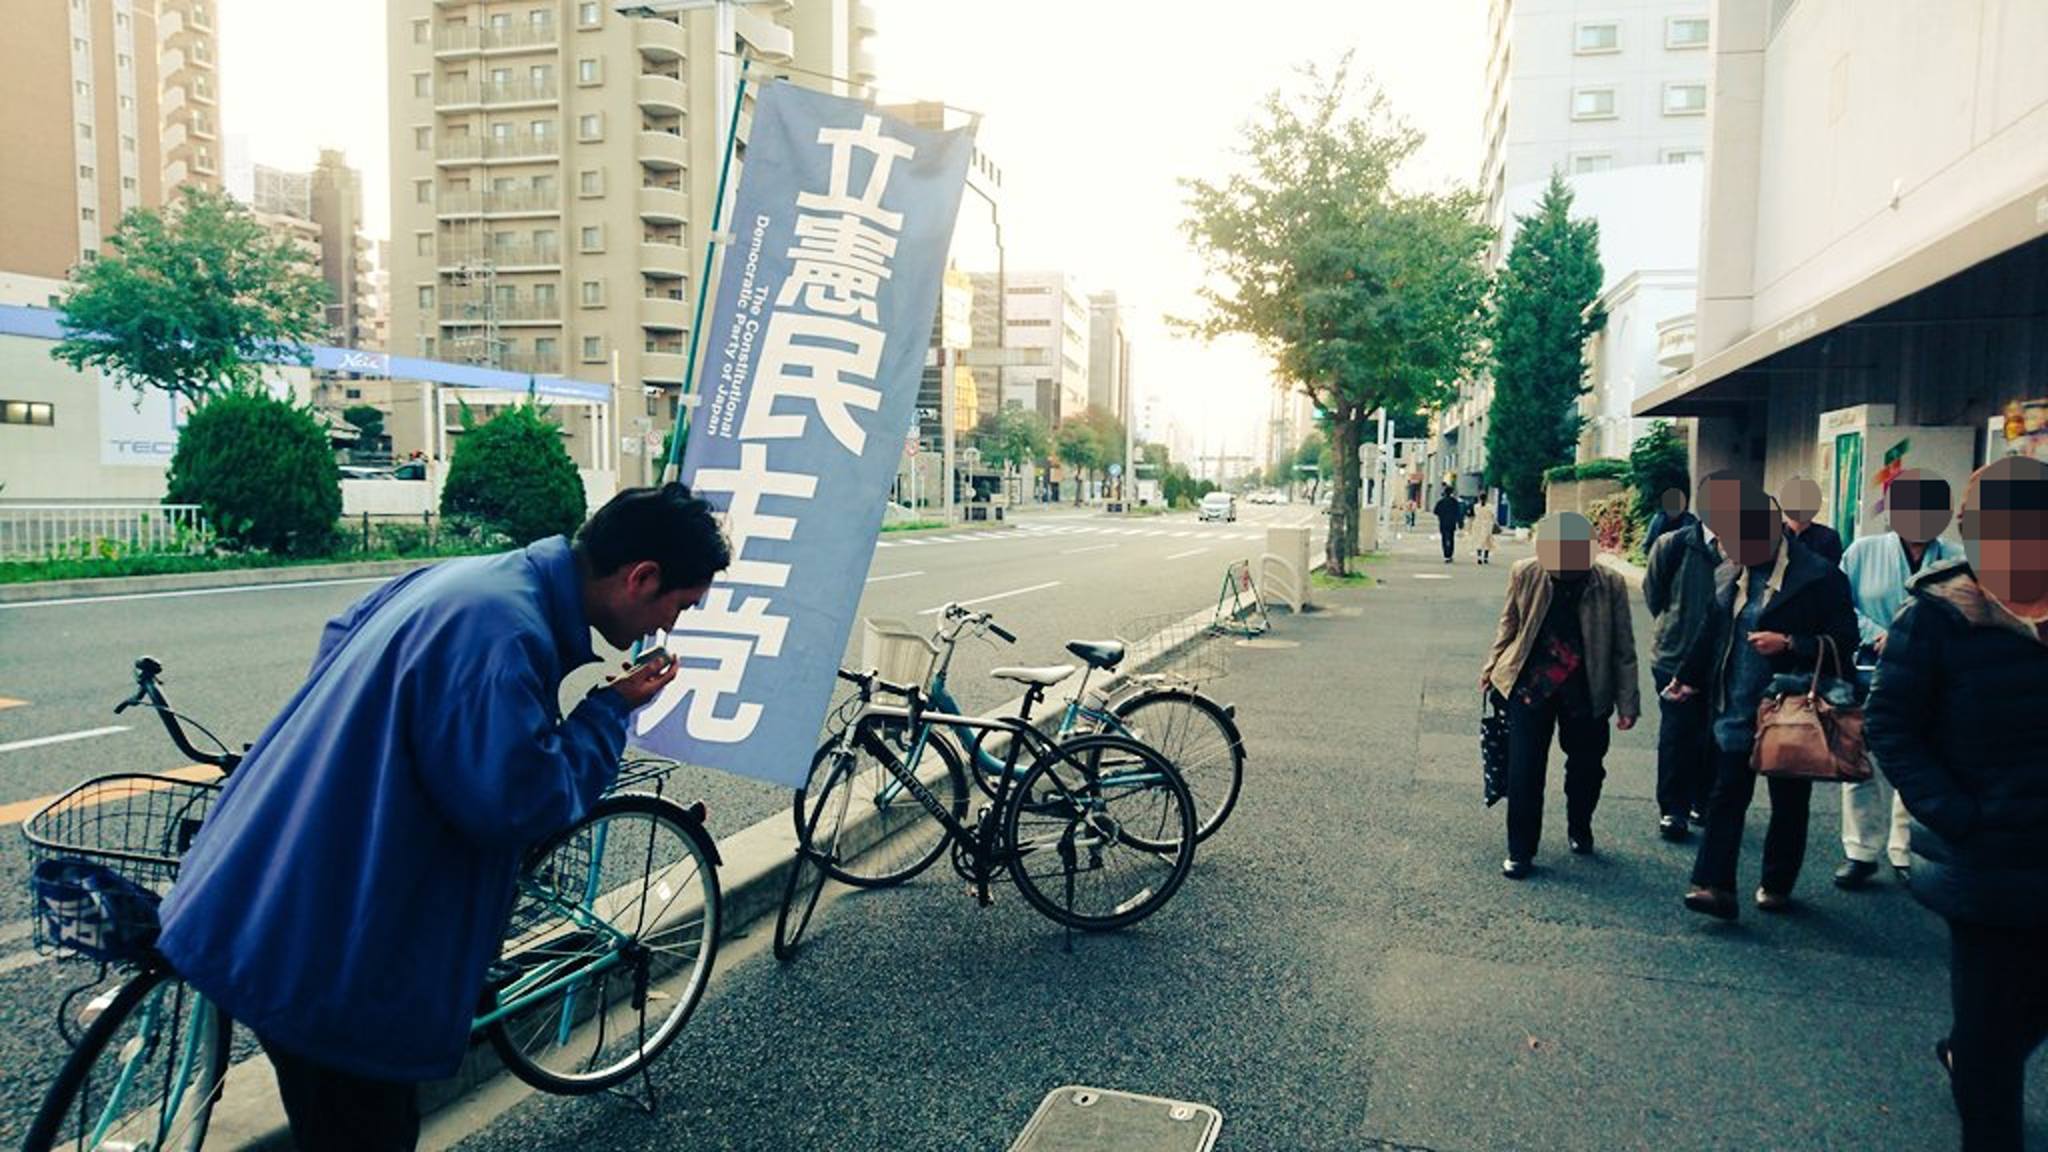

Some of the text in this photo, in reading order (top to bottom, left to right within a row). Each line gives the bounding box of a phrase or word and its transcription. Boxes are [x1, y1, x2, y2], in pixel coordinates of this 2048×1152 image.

[707, 214, 770, 436] Democratic Party of Japan
[719, 286, 769, 438] The Constitutional
[110, 439, 175, 454] TEC
[636, 114, 916, 744] 立憲民主党
